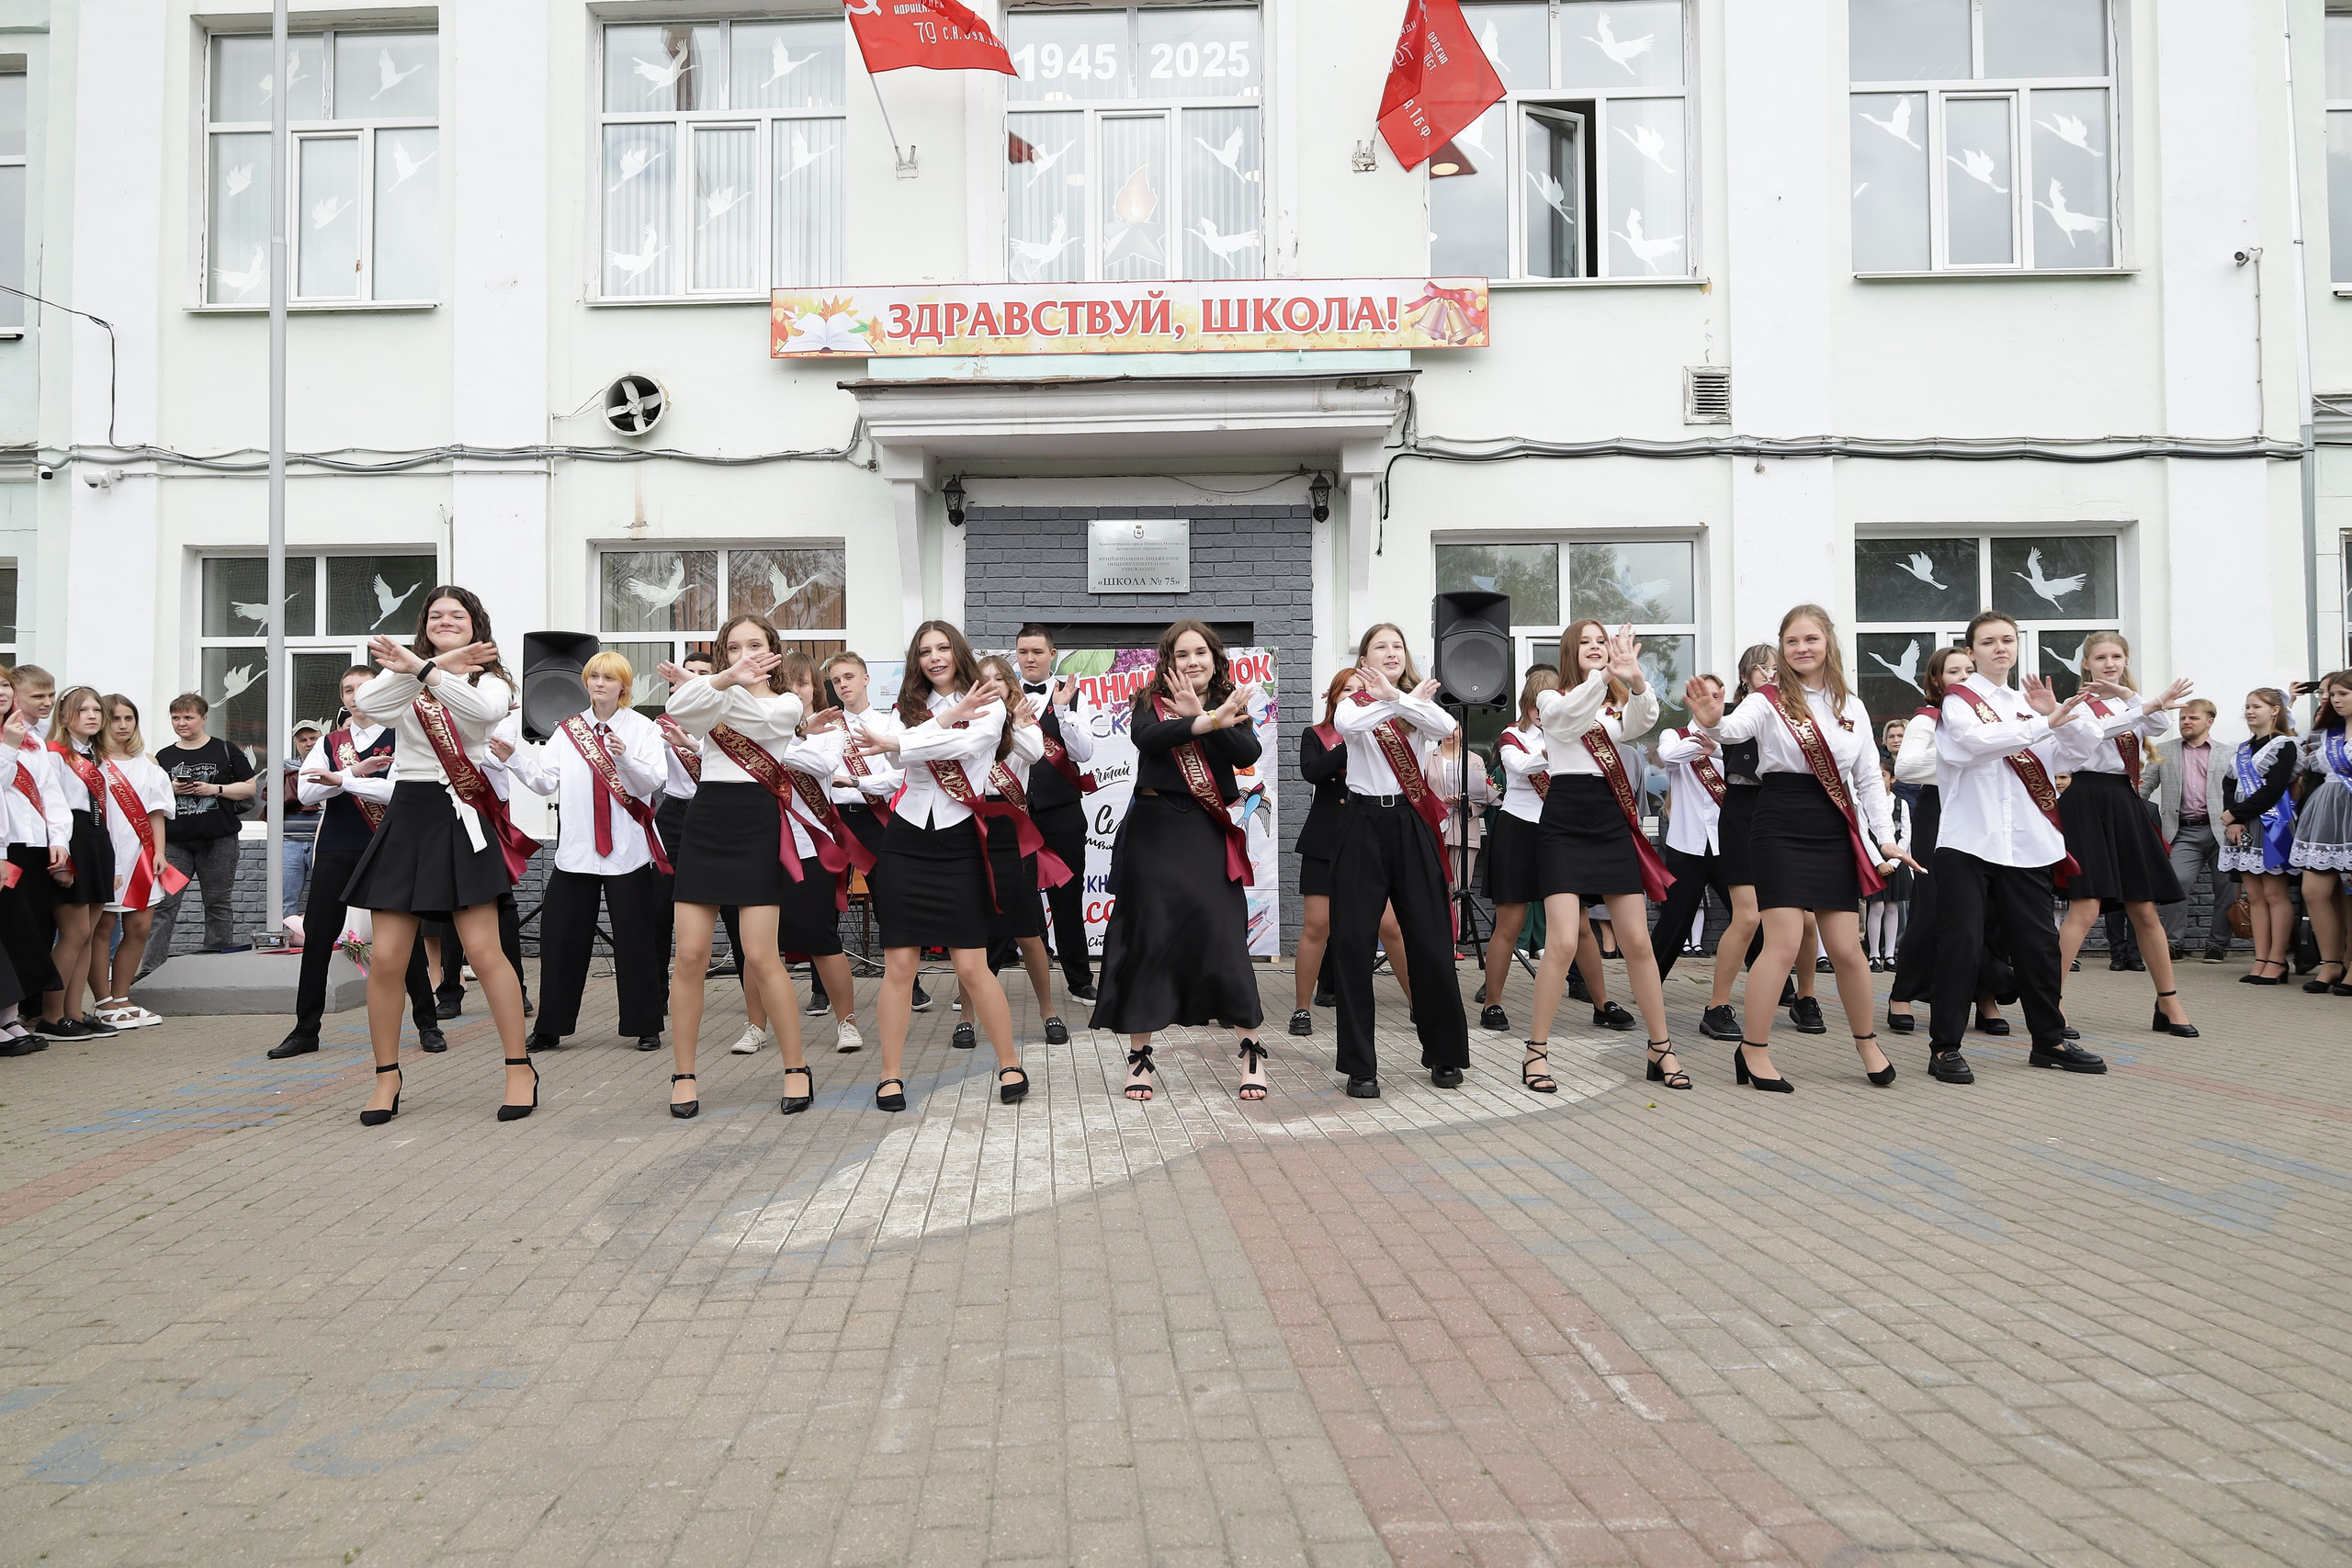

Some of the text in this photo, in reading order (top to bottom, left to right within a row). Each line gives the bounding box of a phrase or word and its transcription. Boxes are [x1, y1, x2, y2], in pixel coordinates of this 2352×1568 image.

[913, 21, 937, 44] 79
[1427, 31, 1449, 65] ОРДЕНА
[1013, 41, 1250, 81] 1945 2025
[888, 290, 1397, 344] ЗДРАВСТВУЙ, ШКОЛА!
[1098, 577, 1147, 586] «ШКОЛА
[1149, 577, 1162, 585] №
[1079, 654, 1272, 711] ДНИЙ ОК
[934, 764, 973, 802] 2025
